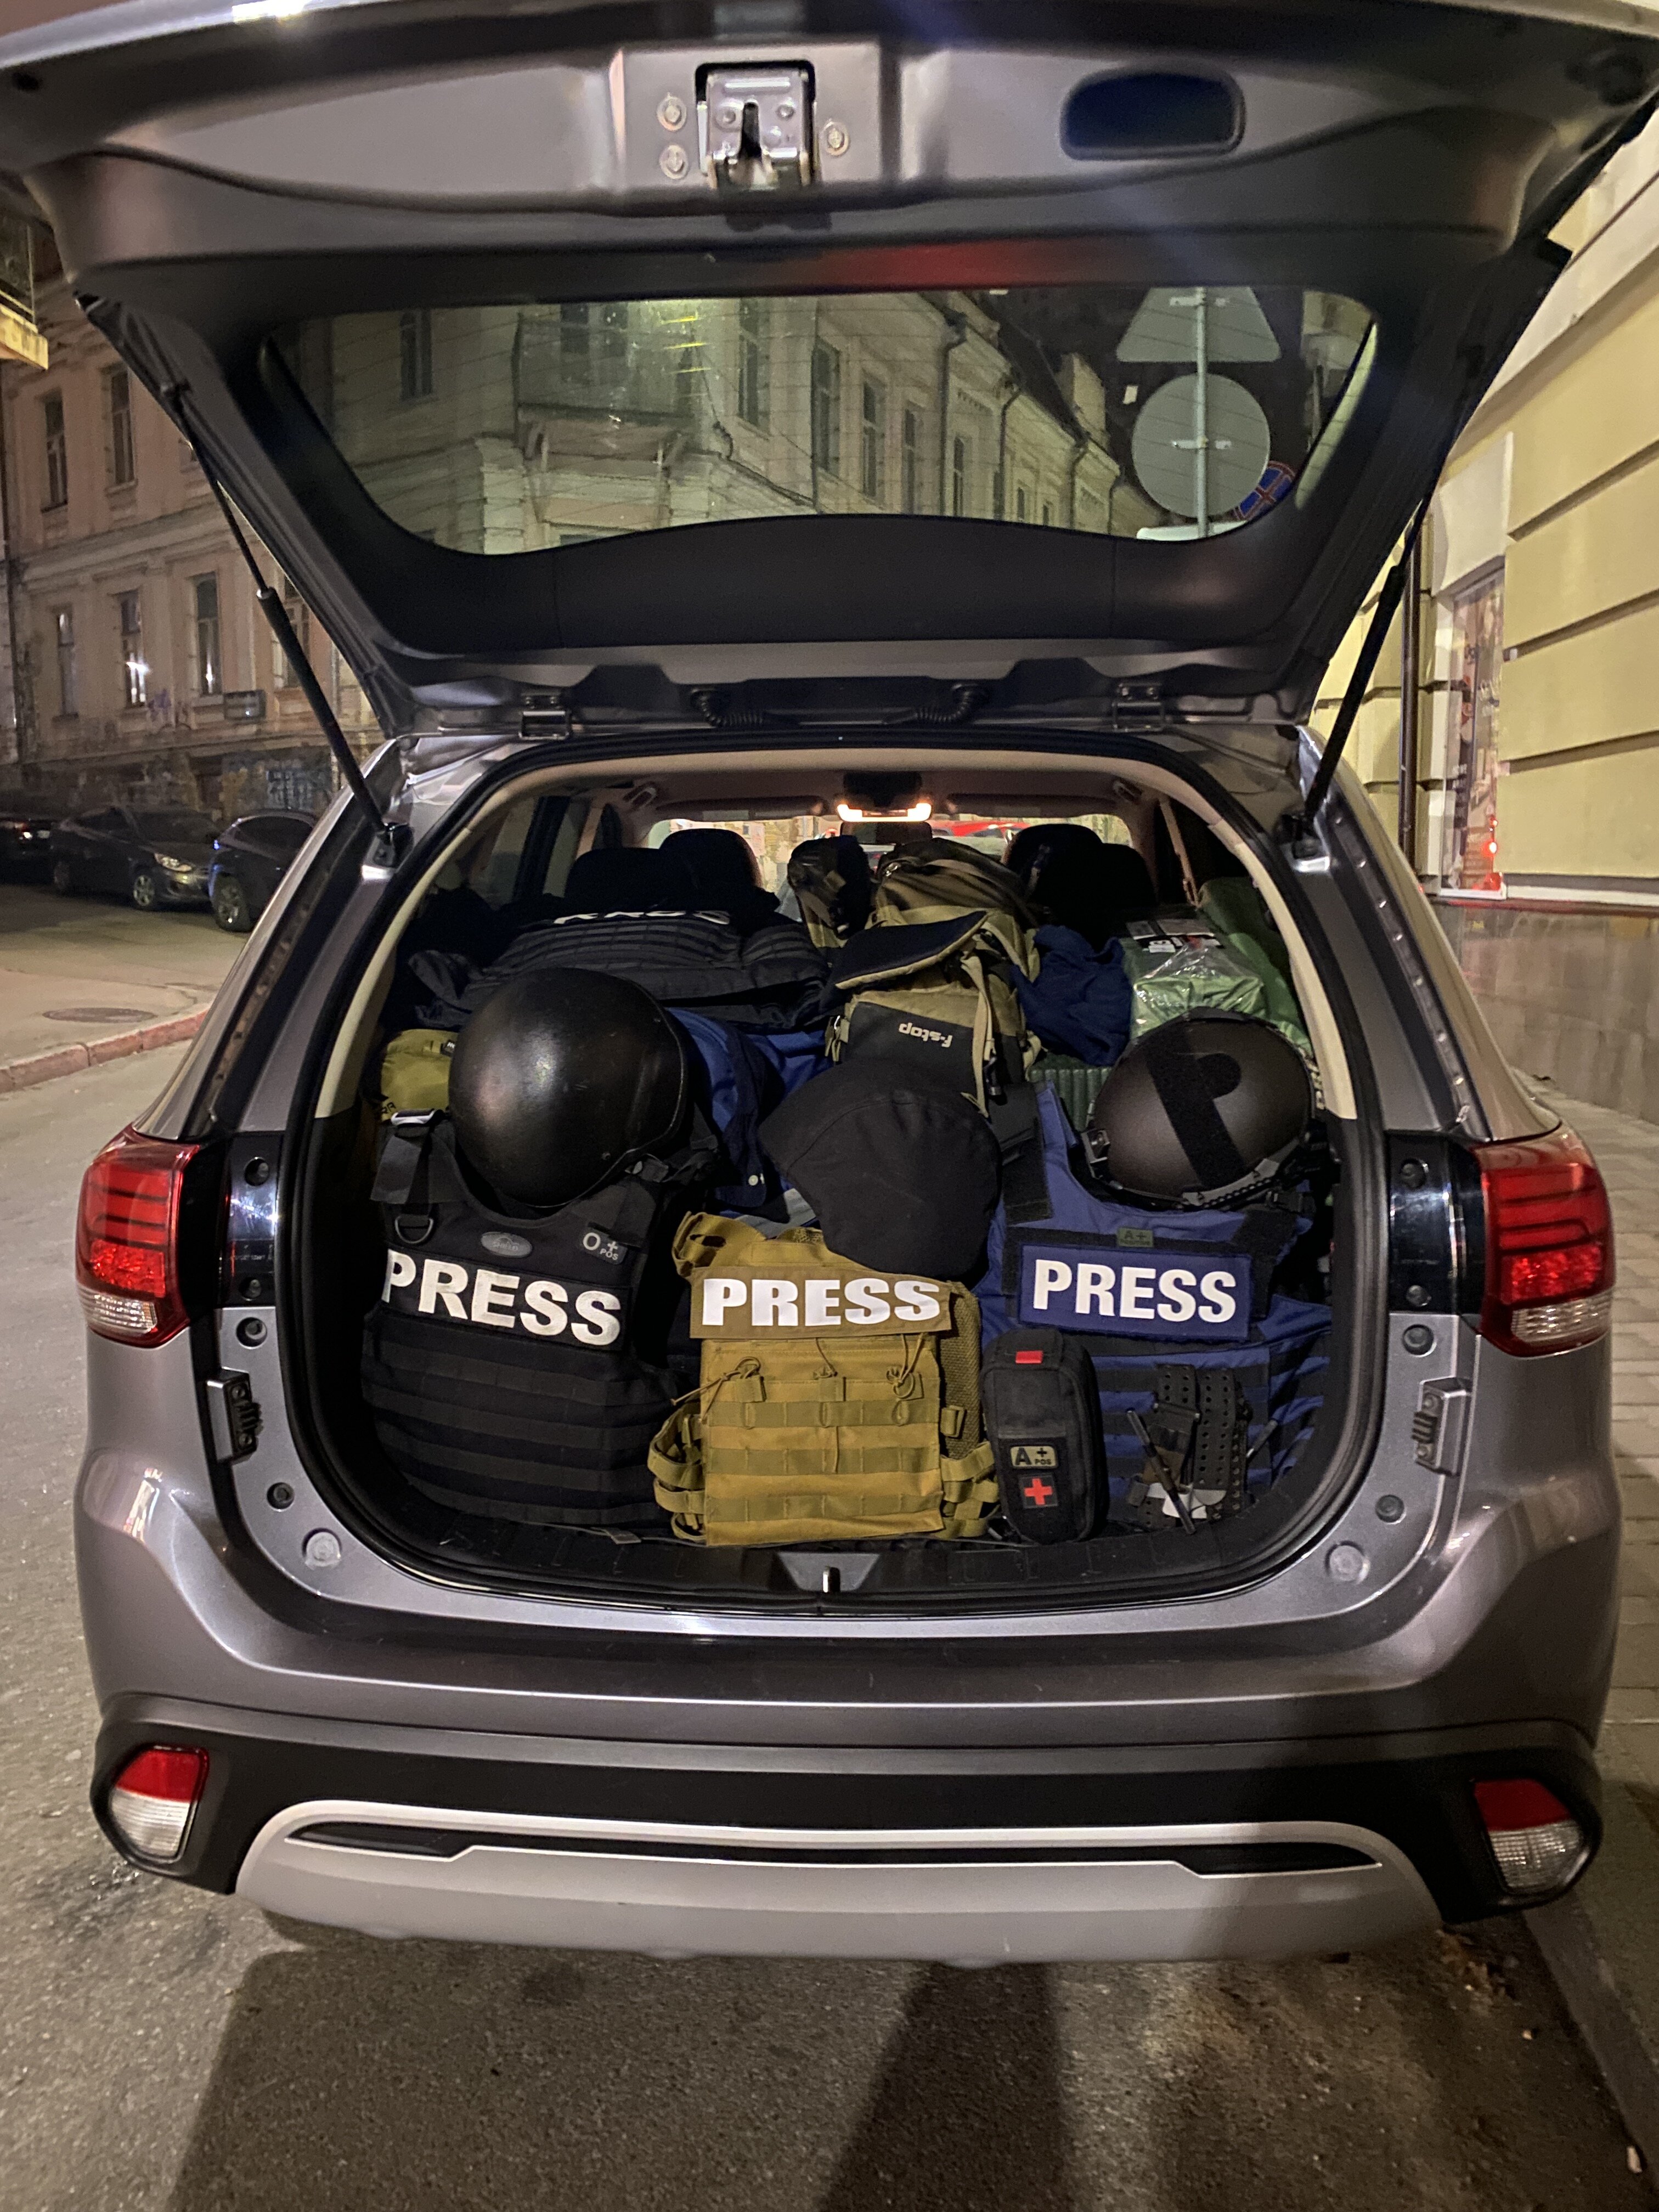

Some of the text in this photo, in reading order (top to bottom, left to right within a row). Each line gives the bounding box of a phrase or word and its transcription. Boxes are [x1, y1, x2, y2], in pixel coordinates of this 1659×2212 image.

[898, 1022, 953, 1048] f-stop
[600, 1248, 618, 1260] POS
[381, 1249, 621, 1346] PRESS
[702, 1278, 940, 1327] PRESS
[1032, 1259, 1237, 1323] PRESS
